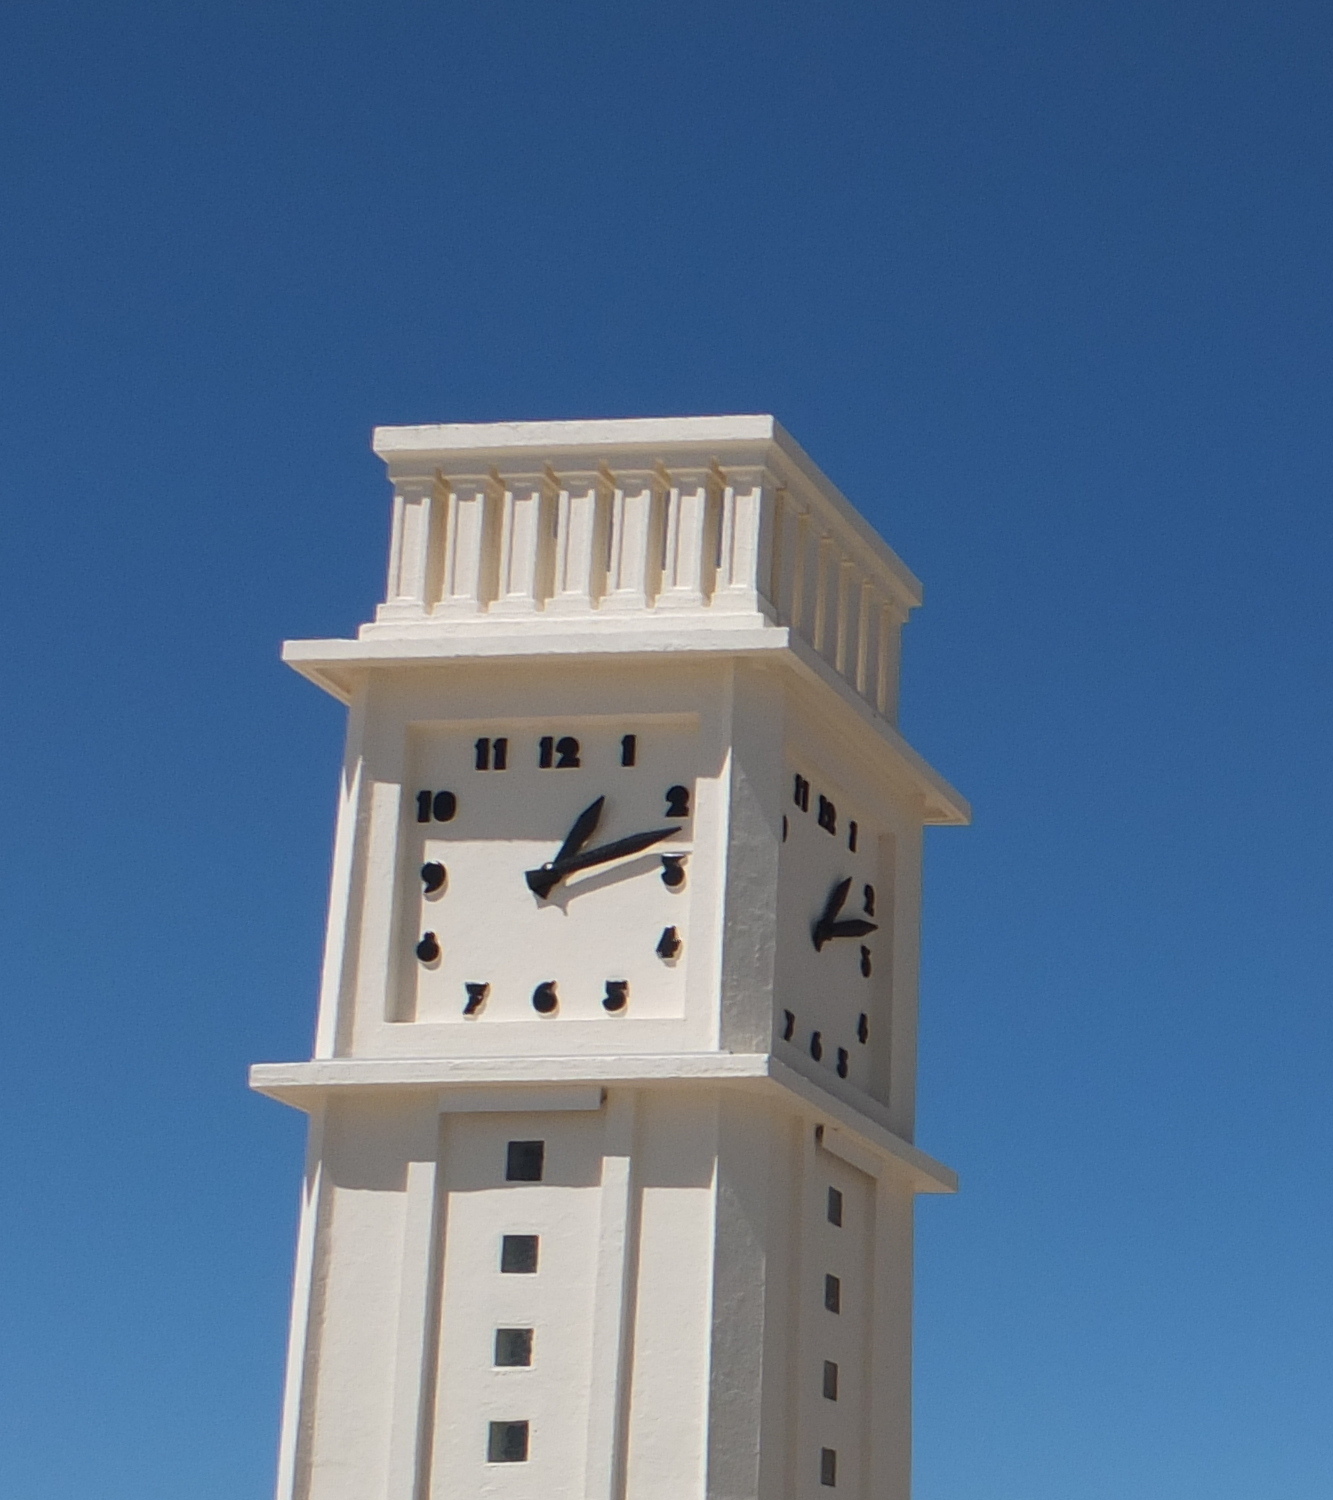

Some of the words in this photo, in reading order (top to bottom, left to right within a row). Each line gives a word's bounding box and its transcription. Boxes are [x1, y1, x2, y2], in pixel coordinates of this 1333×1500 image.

[475, 738, 508, 770] 11
[539, 736, 580, 768] 12
[621, 735, 637, 767] 1
[417, 790, 457, 823] 10
[665, 785, 689, 817] 2
[795, 774, 809, 813] 11
[849, 821, 857, 853] 1
[421, 861, 446, 893] 9
[661, 853, 685, 886] 3
[416, 932, 439, 962] 8
[656, 926, 681, 958] 4
[463, 982, 490, 1015] 7
[532, 980, 558, 1013] 6
[602, 980, 628, 1012] 5
